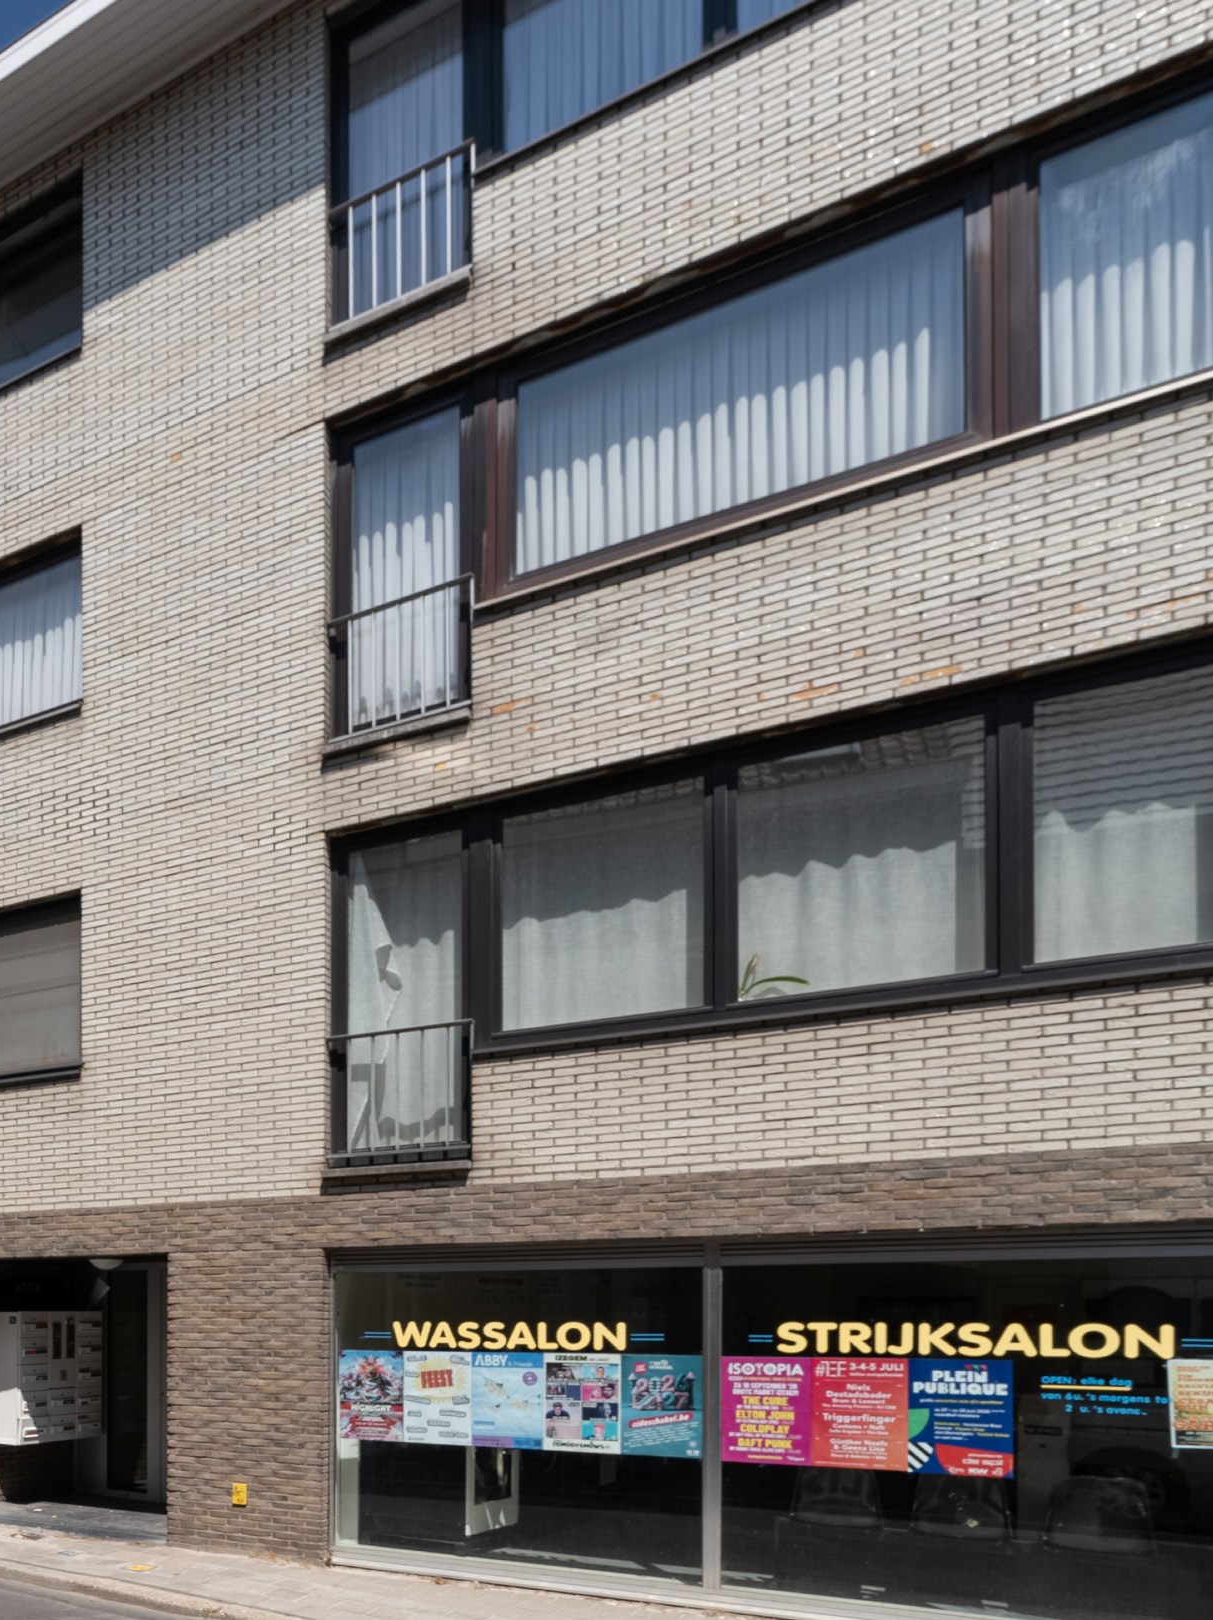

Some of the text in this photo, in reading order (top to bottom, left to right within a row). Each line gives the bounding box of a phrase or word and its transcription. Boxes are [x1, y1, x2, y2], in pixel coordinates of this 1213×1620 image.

[392, 1321, 627, 1351] WASSALON
[776, 1321, 1175, 1359] STRIJKSALON
[475, 1355, 508, 1367] ABBY
[728, 1362, 804, 1376] ISOTOPIA
[849, 1363, 876, 1371] 3-4-5
[879, 1363, 904, 1371] JULI
[931, 1370, 988, 1383] PLEIN
[1040, 1376, 1133, 1387] OPEN: elke dag
[846, 1383, 871, 1391] Niels
[913, 1382, 1008, 1396] PUBLIQUE
[825, 1390, 892, 1399] Destadsbader
[1099, 1395, 1150, 1404] morgens
[742, 1396, 788, 1406] THE CURE
[735, 1410, 795, 1420] ELTON JOHN
[822, 1412, 896, 1424] Triggerfinger
[740, 1424, 790, 1434] COLDPLAY
[738, 1438, 792, 1449] DAFT PUNK
